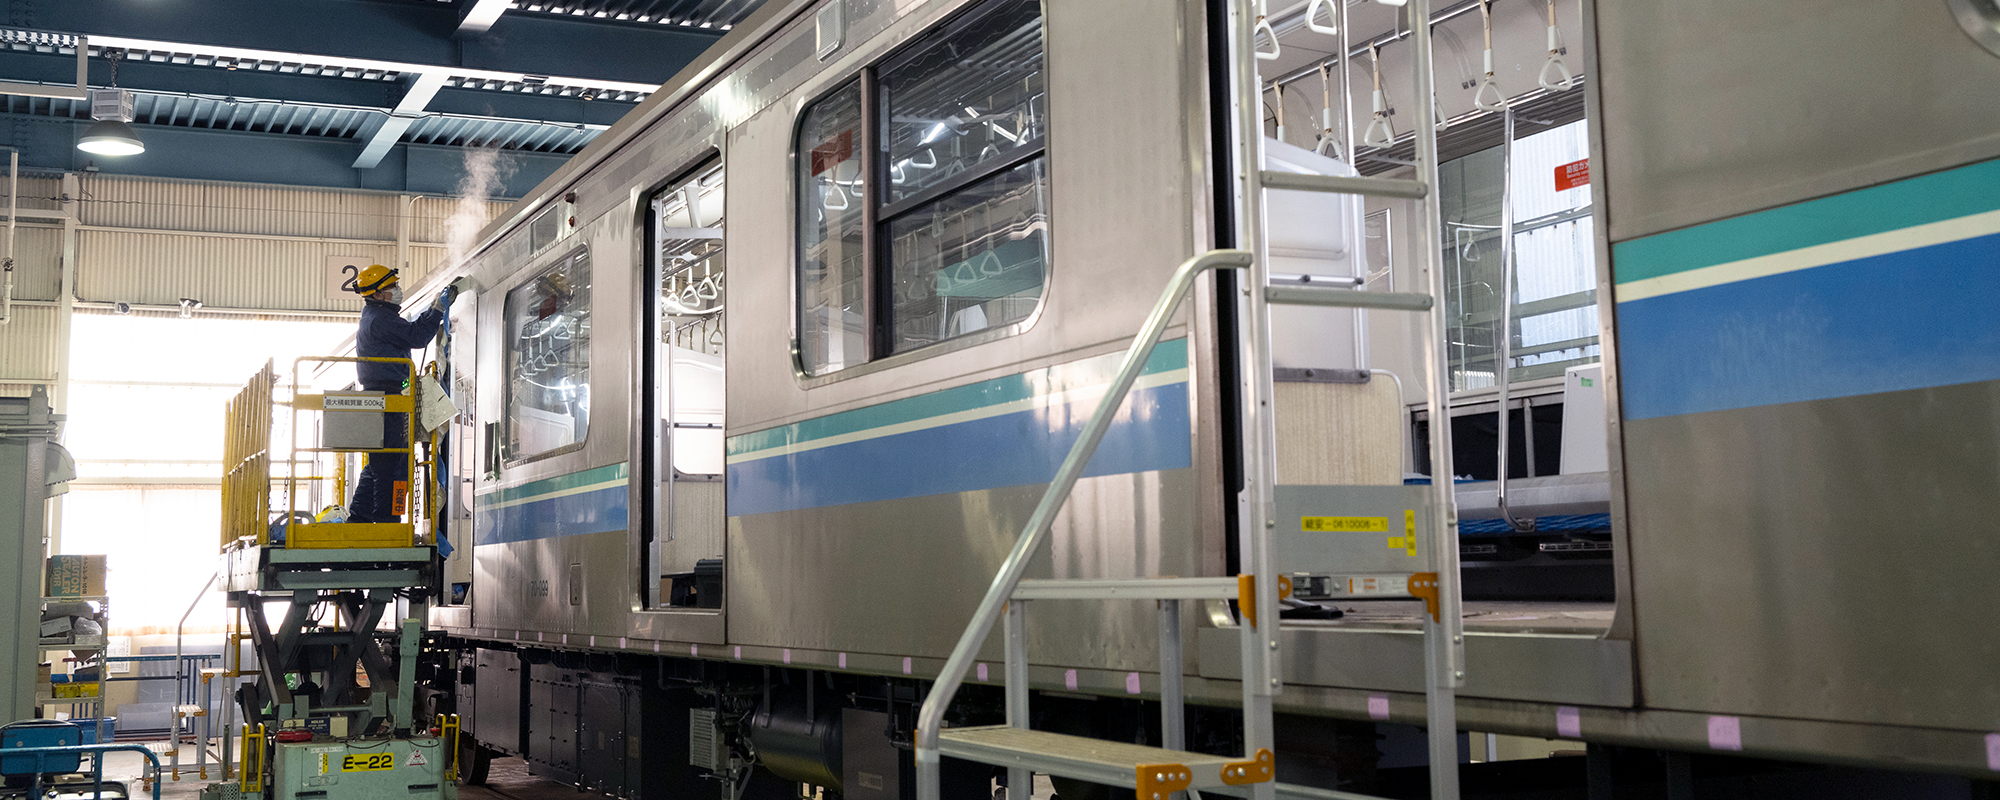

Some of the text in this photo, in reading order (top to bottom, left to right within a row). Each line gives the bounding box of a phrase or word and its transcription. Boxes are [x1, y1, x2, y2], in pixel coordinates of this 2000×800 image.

[341, 264, 359, 292] 2
[364, 399, 384, 408] 500kg
[395, 488, 404, 513] 充電中
[53, 566, 61, 587] 101R
[61, 556, 71, 595] SEALER
[71, 557, 80, 594] AUTON
[530, 579, 549, 597] 70-099
[343, 755, 392, 770] E-22
